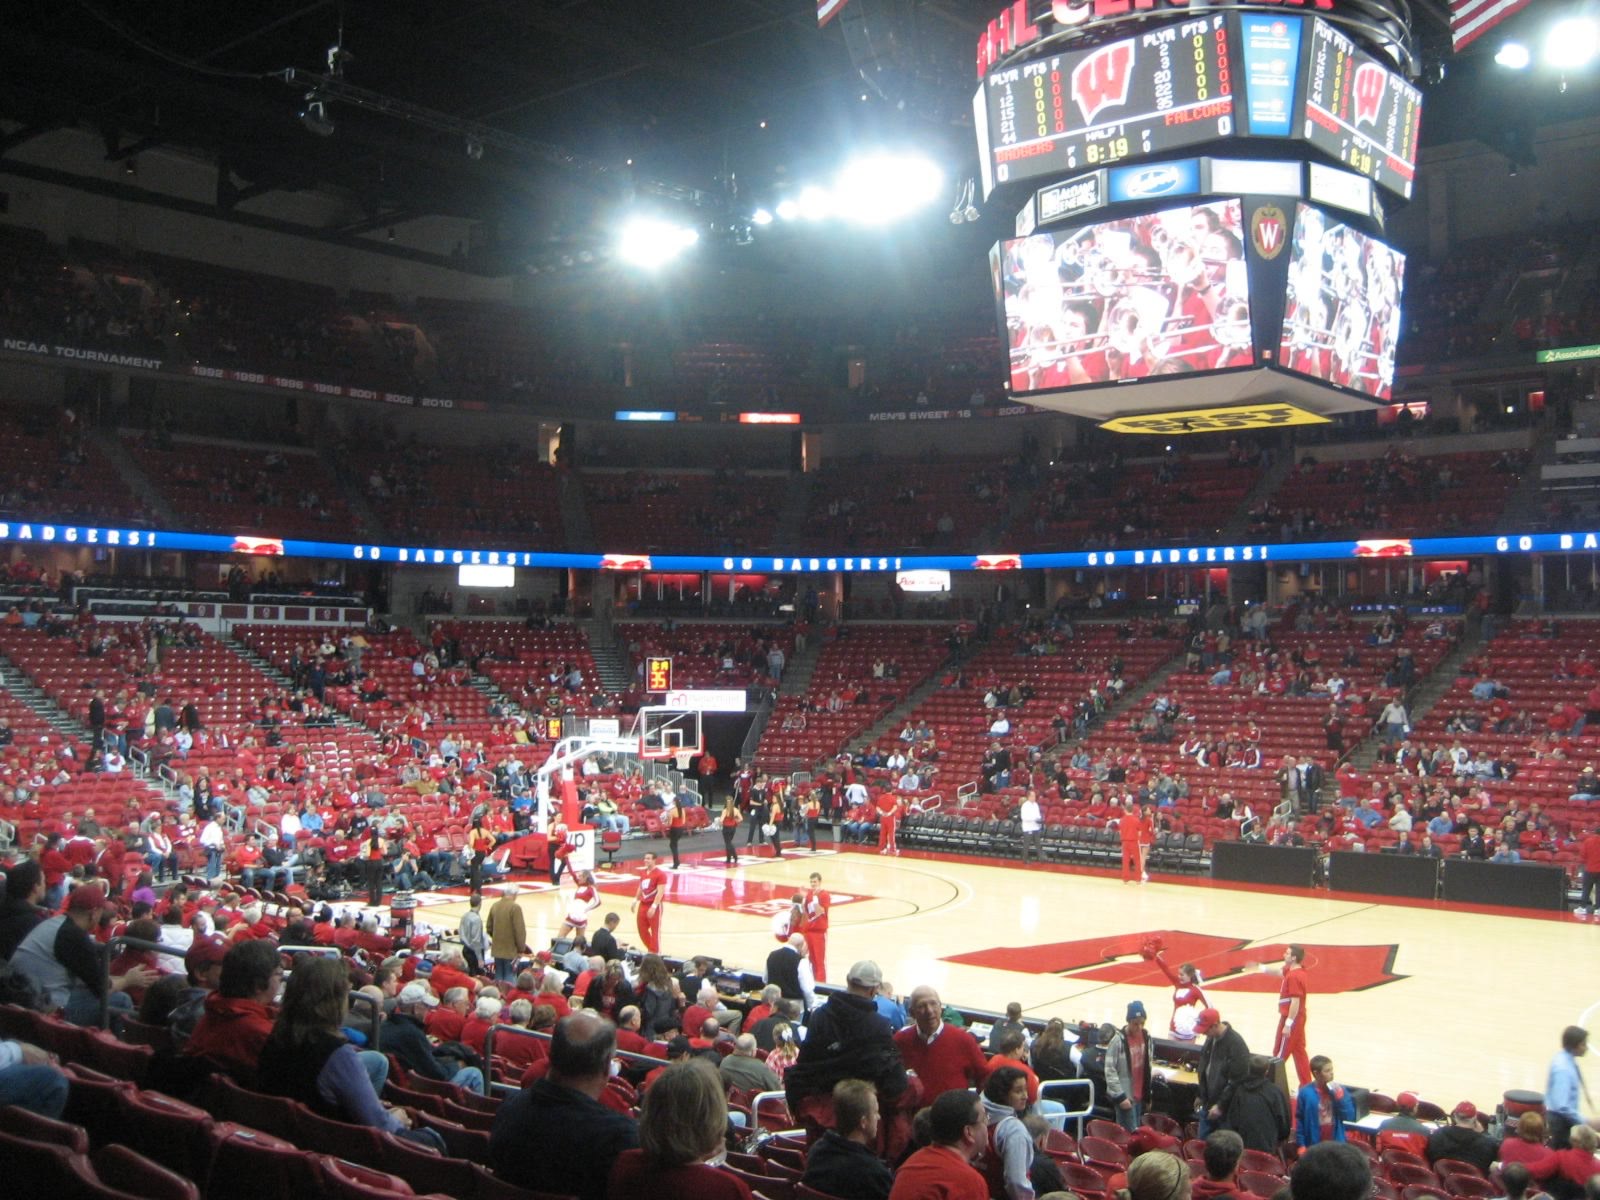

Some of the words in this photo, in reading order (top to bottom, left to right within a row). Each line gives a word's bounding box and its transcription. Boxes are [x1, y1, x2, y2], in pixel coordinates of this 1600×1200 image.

[1181, 20, 1208, 38] PTS
[1213, 15, 1223, 30] F
[1160, 44, 1168, 56] 2
[1193, 35, 1202, 48] 0
[1215, 29, 1225, 41] 0
[1161, 57, 1170, 69] 3
[1194, 48, 1204, 61] 0
[1217, 42, 1226, 55] 0
[1023, 62, 1047, 78] PTS
[1051, 58, 1060, 71] F
[1154, 70, 1171, 84] 20
[1196, 61, 1205, 74] 0
[1218, 56, 1227, 68] 0
[1005, 84, 1012, 95] 1
[1034, 75, 1043, 88] 0
[1051, 71, 1060, 82] 0
[1156, 83, 1172, 98] 22
[1197, 74, 1206, 87] 0
[1219, 69, 1229, 82] 0
[1198, 88, 1207, 101] 0
[1220, 83, 1230, 95] 0
[1000, 95, 1014, 109] 12
[1035, 88, 1044, 100] 0
[1052, 83, 1061, 95] 0
[1000, 107, 1015, 121] 15
[1036, 100, 1045, 112] 0
[1053, 96, 1062, 108] 0
[1165, 101, 1232, 126] FALCONS
[1001, 120, 1015, 133] 21
[1037, 112, 1046, 124] 0
[1054, 108, 1063, 120] 0
[1218, 116, 1231, 136] 0
[1002, 133, 1017, 145] 44
[1038, 125, 1047, 137] 0
[1055, 121, 1065, 132] 0
[1141, 129, 1151, 140] F
[996, 140, 1056, 163] BADGERS
[1086, 137, 1129, 163] 8:19
[997, 164, 1009, 181] 0
[1259, 222, 1279, 249] W
[4, 338, 49, 354] NCAA
[55, 346, 163, 370] TOURNAMENT
[422, 398, 453, 409] 2010
[869, 412, 907, 422] MEN'S
[909, 410, 949, 420] SWEET
[1119, 407, 1296, 428] BEST
[1149, 415, 1290, 432] BUY
[1497, 536, 1533, 552] GO
[353, 545, 380, 560] GO
[398, 548, 531, 567] BADGERS!
[723, 557, 753, 571] GO
[773, 557, 902, 571] BADGERS!
[1087, 552, 1115, 566] GO
[1135, 546, 1268, 564] BADGERS!
[650, 671, 666, 689] 35
